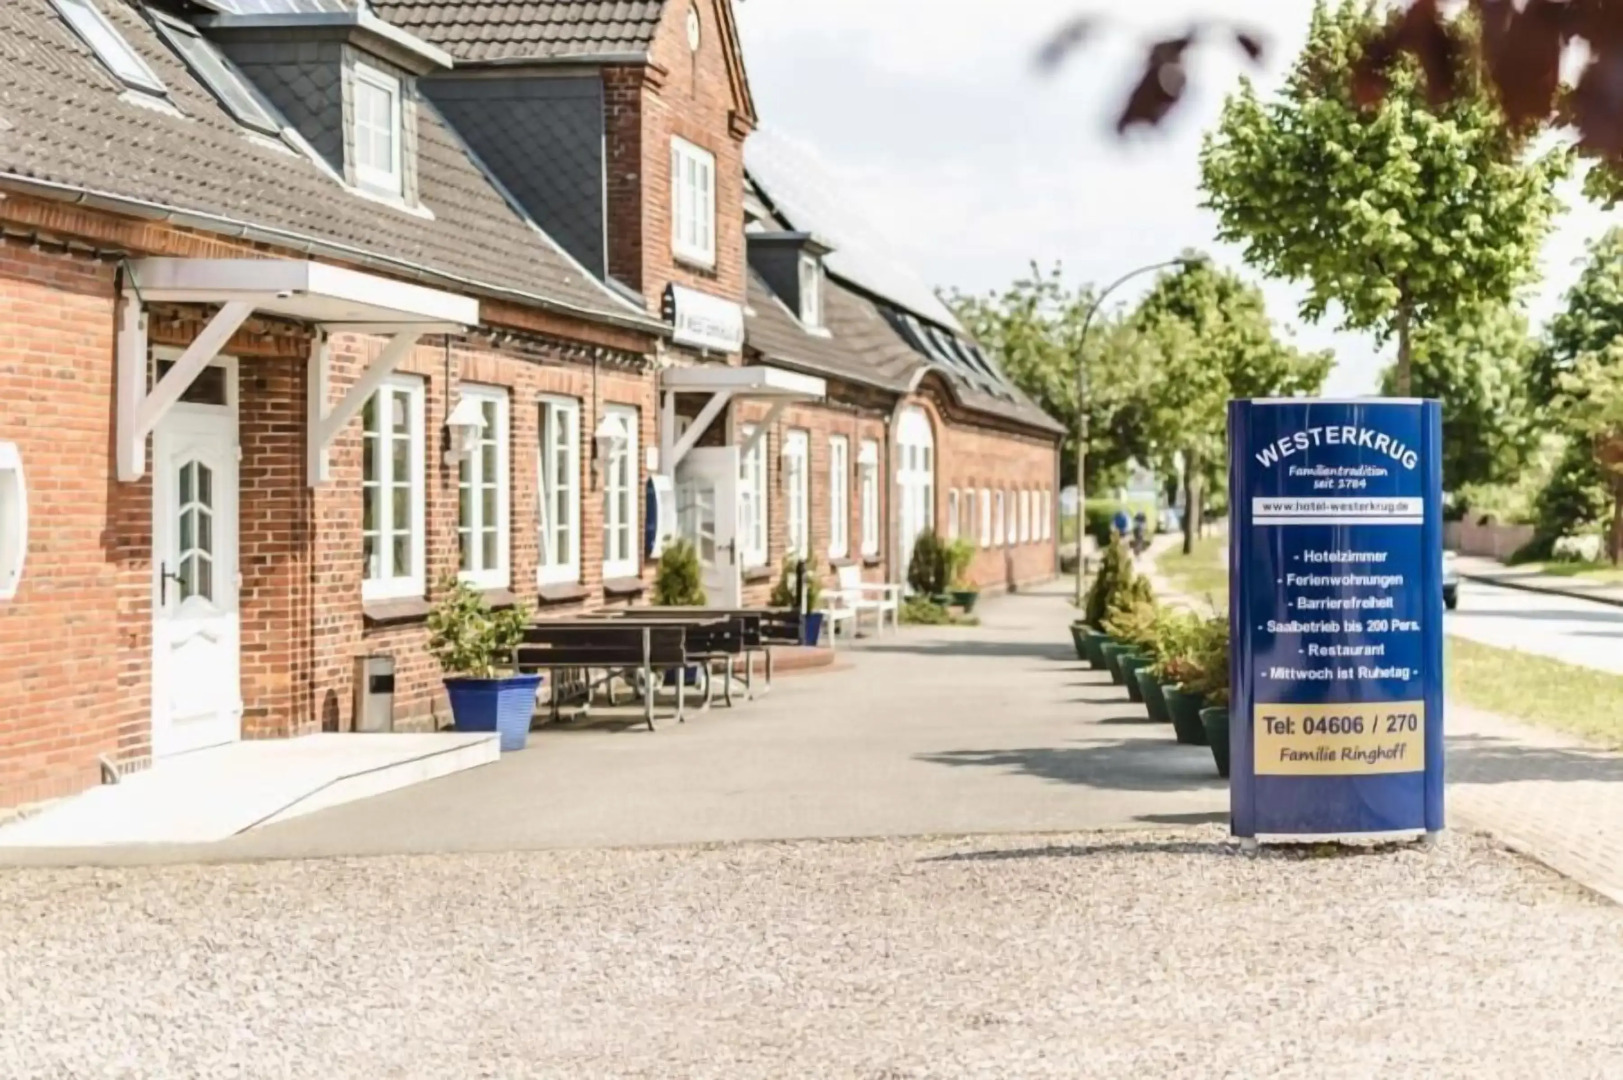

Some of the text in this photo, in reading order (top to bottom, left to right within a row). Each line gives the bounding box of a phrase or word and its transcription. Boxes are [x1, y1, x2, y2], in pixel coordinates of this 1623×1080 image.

[1255, 425, 1418, 470] WESTERKRUG
[1289, 465, 1388, 477] Familientradition
[1313, 478, 1334, 489] seit
[1262, 501, 1409, 513] www.hotel-westerkrug.de
[1304, 550, 1388, 563] Hotelzimmer
[1286, 573, 1404, 588] Ferienwohnungen
[1297, 596, 1394, 610] Barrierefreiheit
[1267, 619, 1340, 633] Saalbetrieb
[1344, 619, 1363, 633] bis
[1367, 619, 1389, 632] 200
[1308, 643, 1385, 656] Restaurant
[1270, 665, 1410, 680] Mittwoch ist Ruhetag
[1302, 716, 1364, 734] 04606
[1371, 714, 1379, 733] /
[1386, 713, 1418, 733] 270
[1279, 743, 1408, 764] Familie Ringhoff
